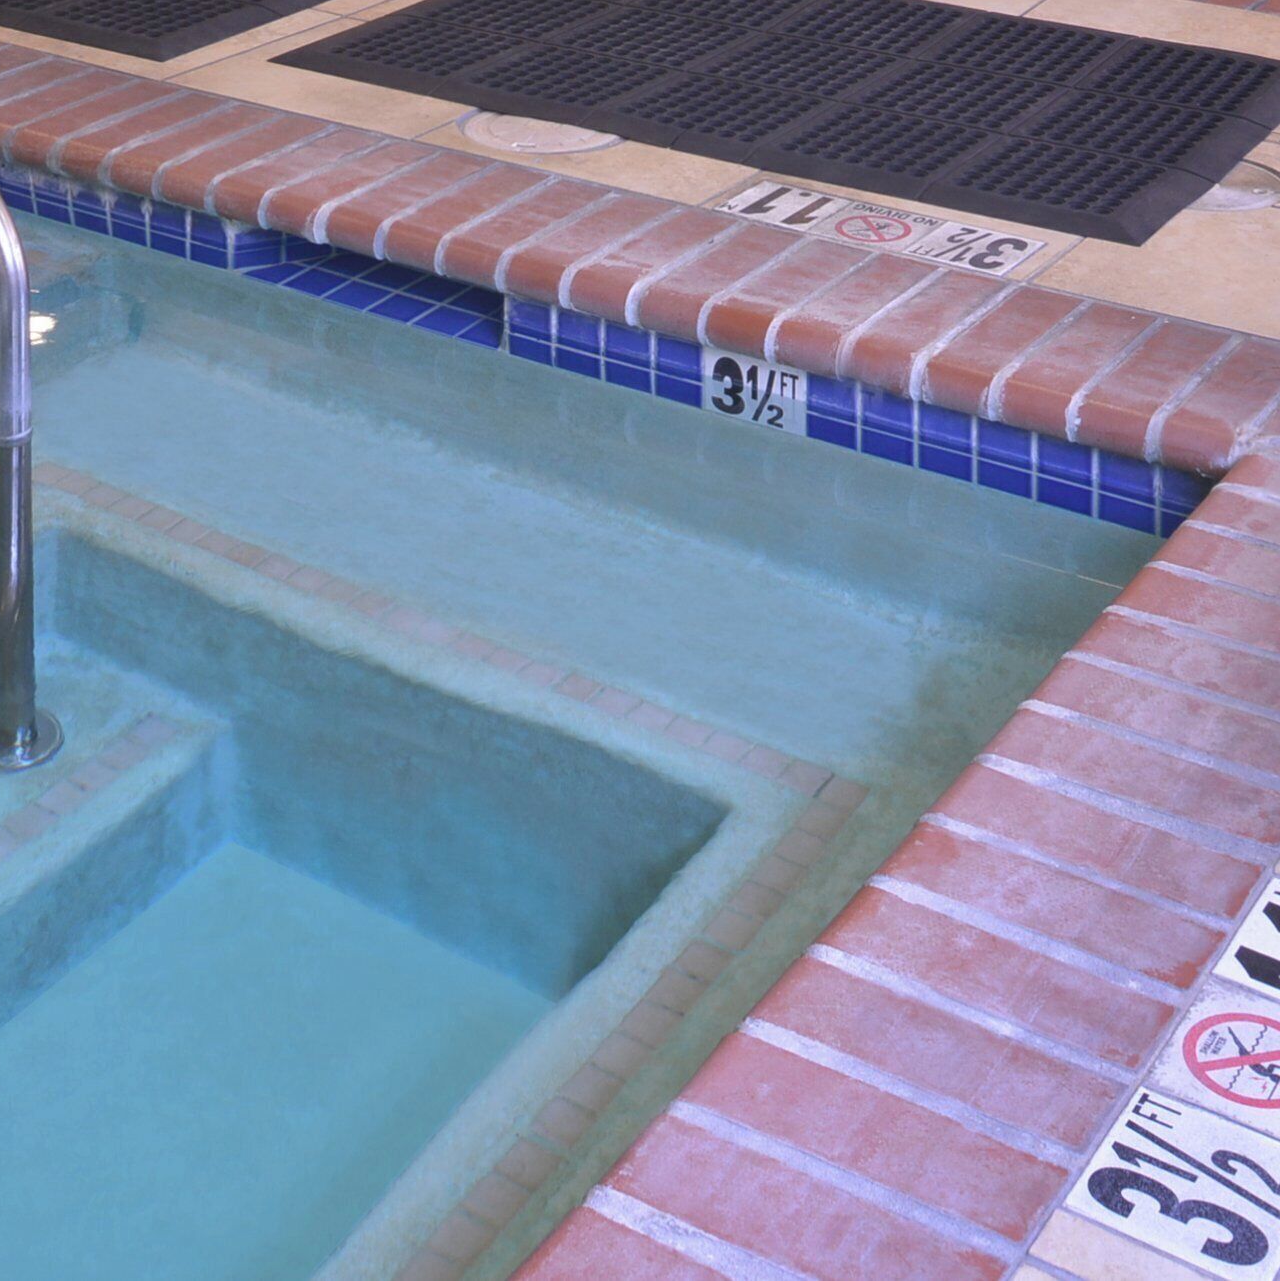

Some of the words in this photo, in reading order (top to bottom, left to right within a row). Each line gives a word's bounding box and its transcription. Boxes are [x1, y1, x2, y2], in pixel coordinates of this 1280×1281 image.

[740, 186, 833, 226] 1.1
[854, 203, 909, 222] DIVING
[912, 216, 938, 228] NO
[909, 245, 931, 256] FT
[780, 372, 799, 400] FT
[1131, 1092, 1182, 1130] FT
